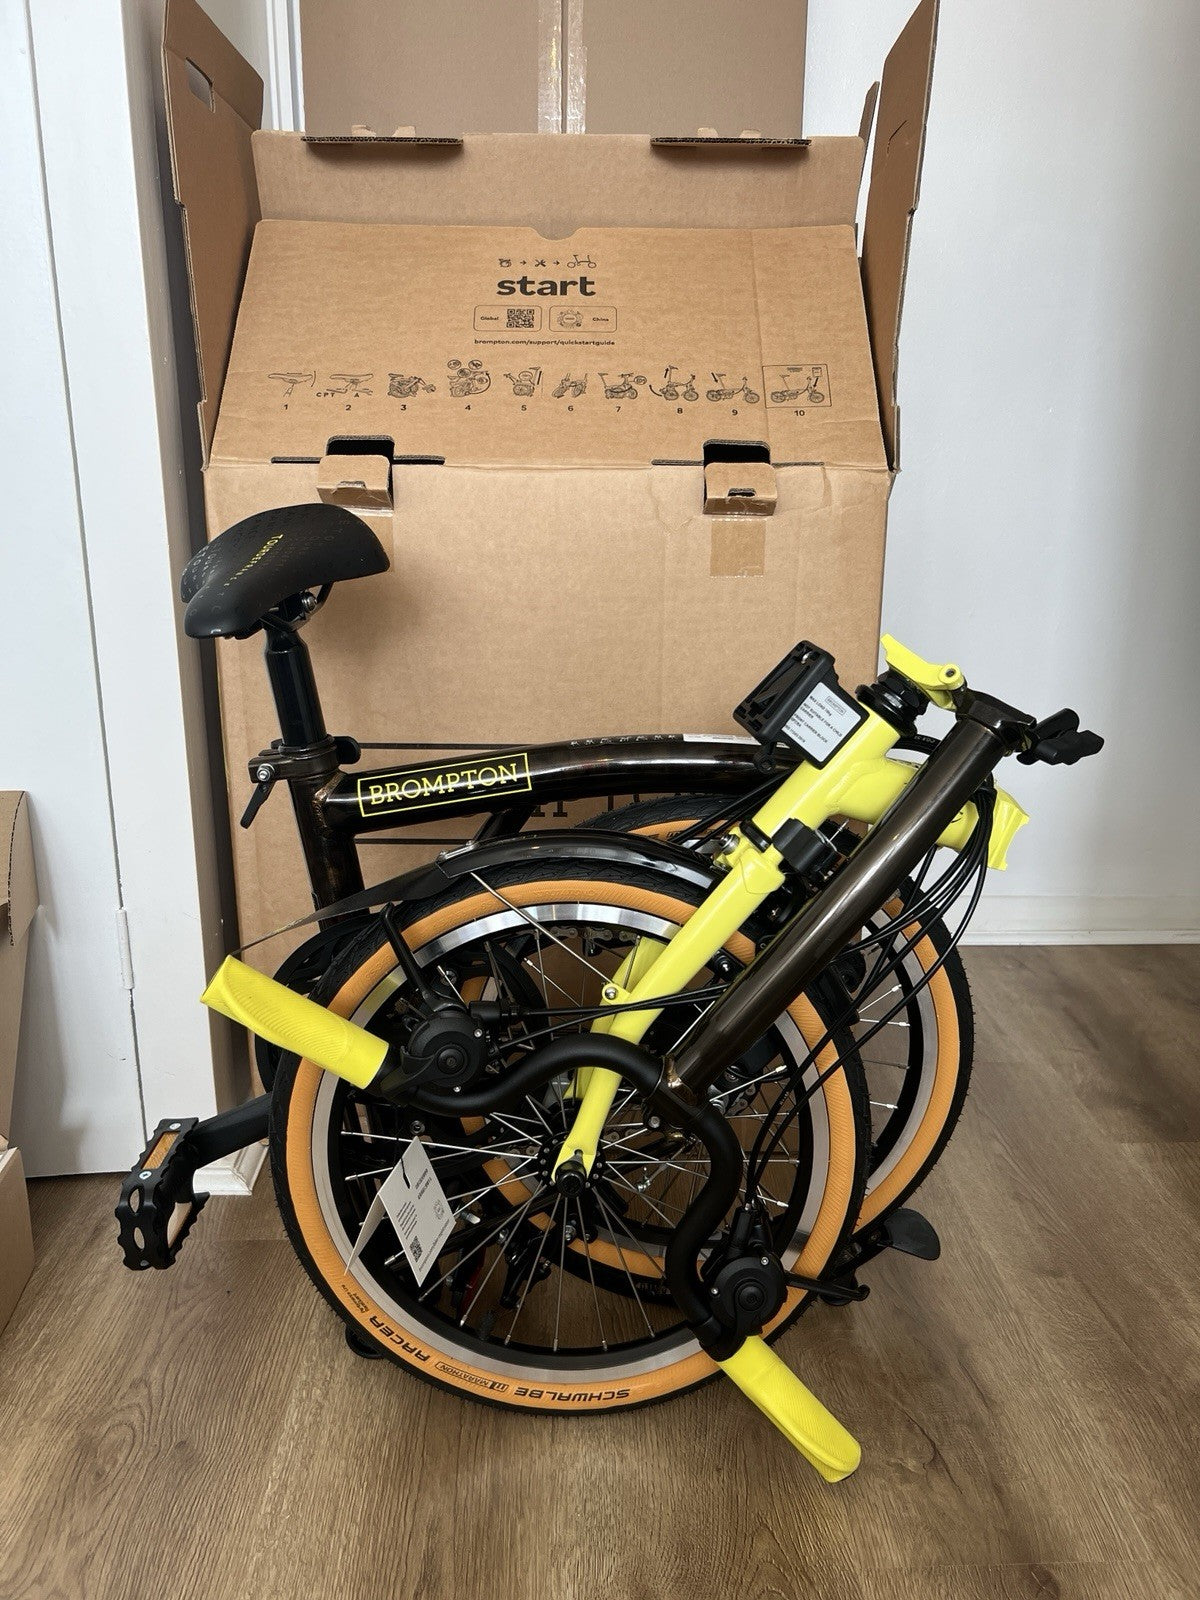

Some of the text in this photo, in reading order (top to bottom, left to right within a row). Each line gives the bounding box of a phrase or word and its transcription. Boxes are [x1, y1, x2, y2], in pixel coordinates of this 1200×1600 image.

[496, 276, 597, 297] start
[474, 338, 615, 346] brompton.com/support/quickstartguide
[794, 409, 805, 417] 10
[369, 763, 518, 805] BROMPTON
[369, 1315, 431, 1362] RACER
[439, 1364, 489, 1388] MARATHON
[514, 1386, 631, 1402] SCHWALBE
